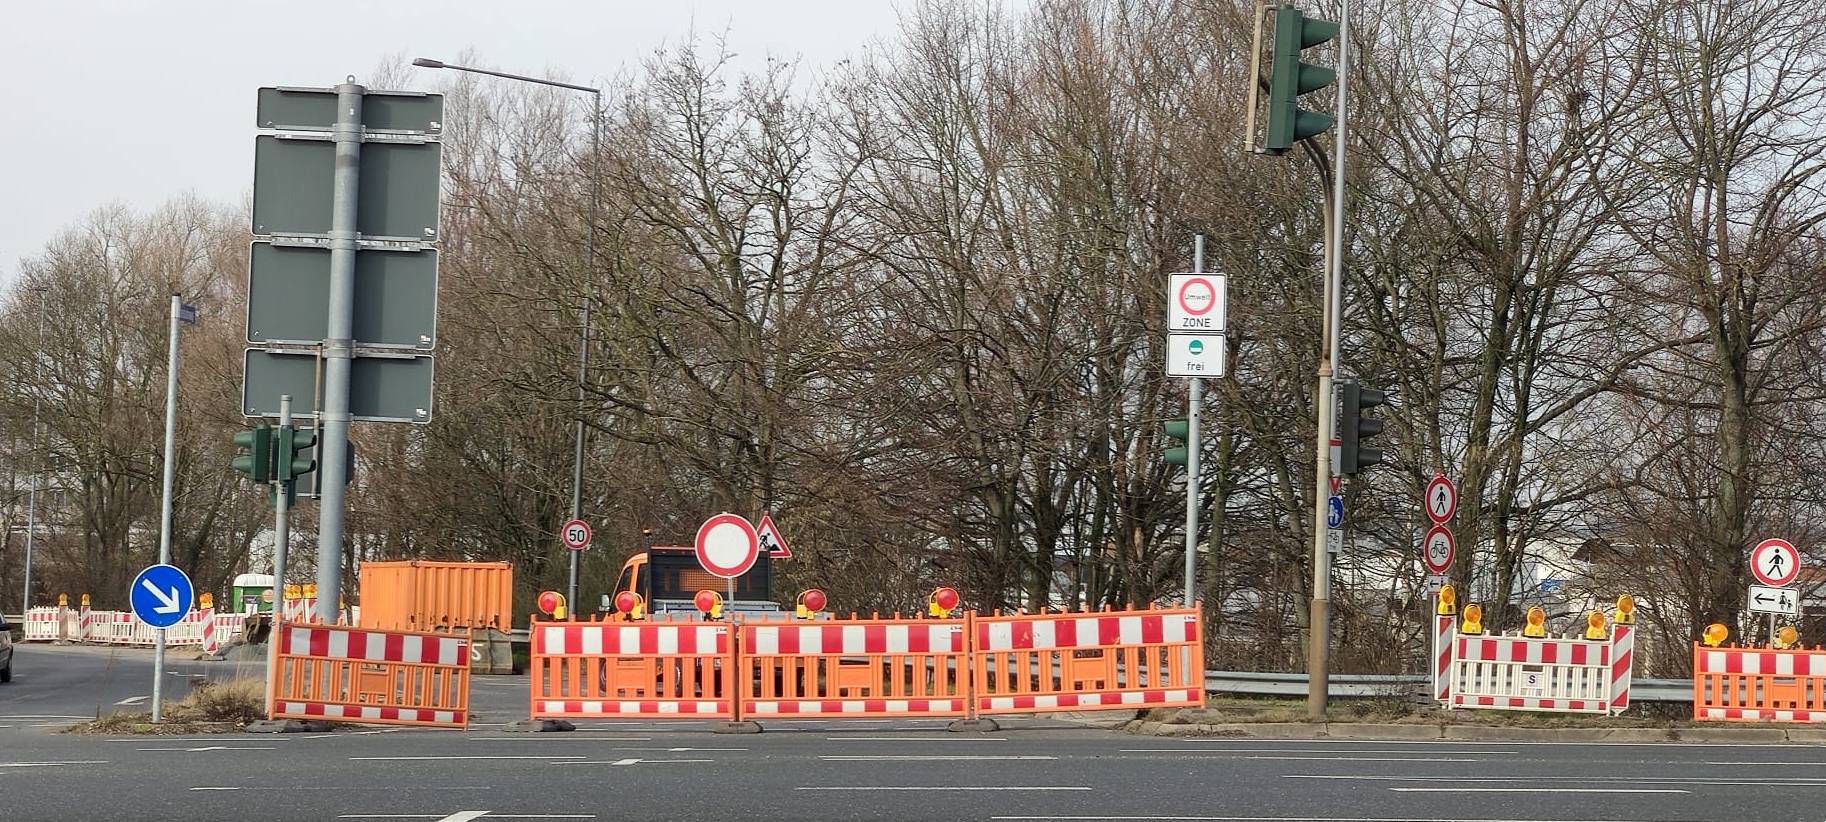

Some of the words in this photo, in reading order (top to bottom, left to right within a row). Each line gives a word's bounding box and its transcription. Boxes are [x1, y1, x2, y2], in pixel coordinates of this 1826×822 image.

[1183, 317, 1211, 327] ZONE
[1187, 362, 1205, 370] frei
[569, 529, 585, 542] 50
[1528, 674, 1536, 684] S
